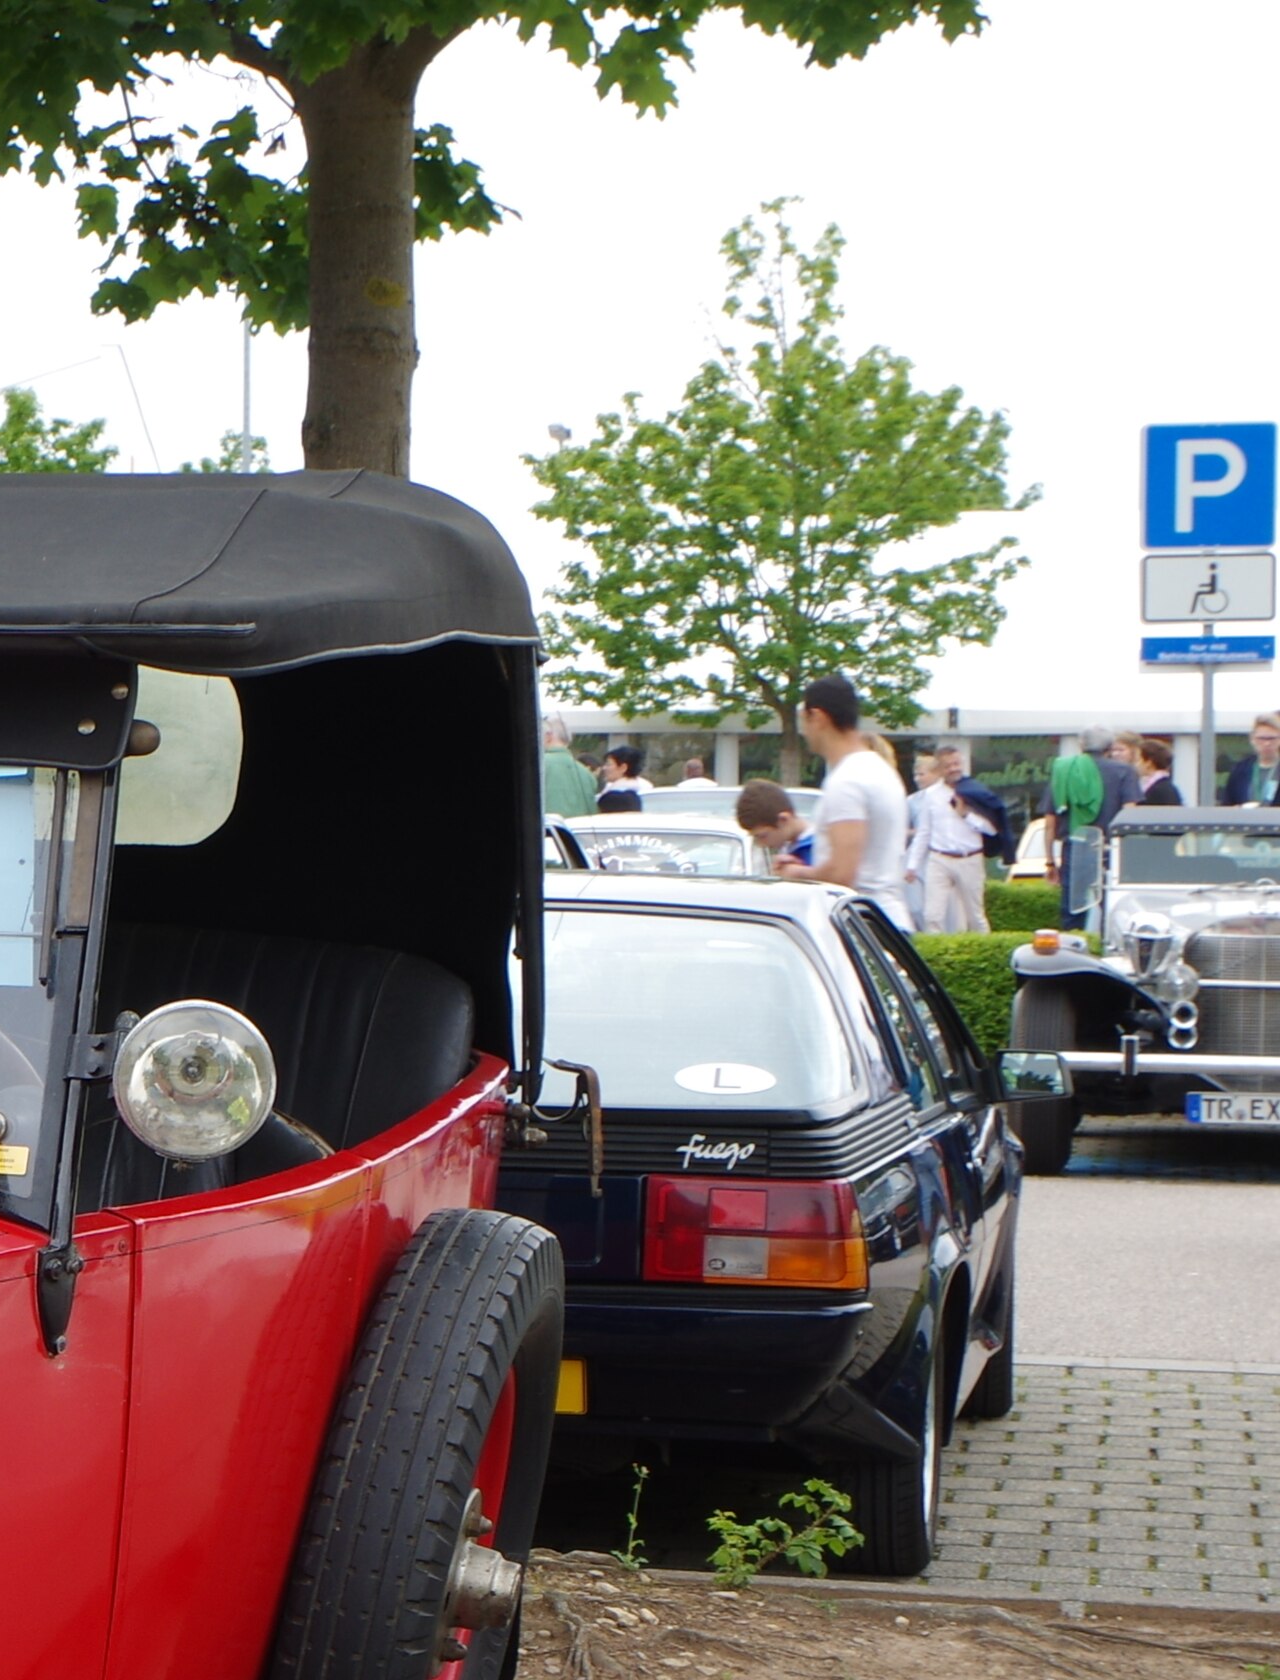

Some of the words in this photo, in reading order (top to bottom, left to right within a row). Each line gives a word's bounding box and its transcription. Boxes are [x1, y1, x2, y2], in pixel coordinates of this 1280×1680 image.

[1175, 438, 1247, 533] P
[713, 1067, 742, 1089] L
[1203, 1098, 1232, 1119] TR
